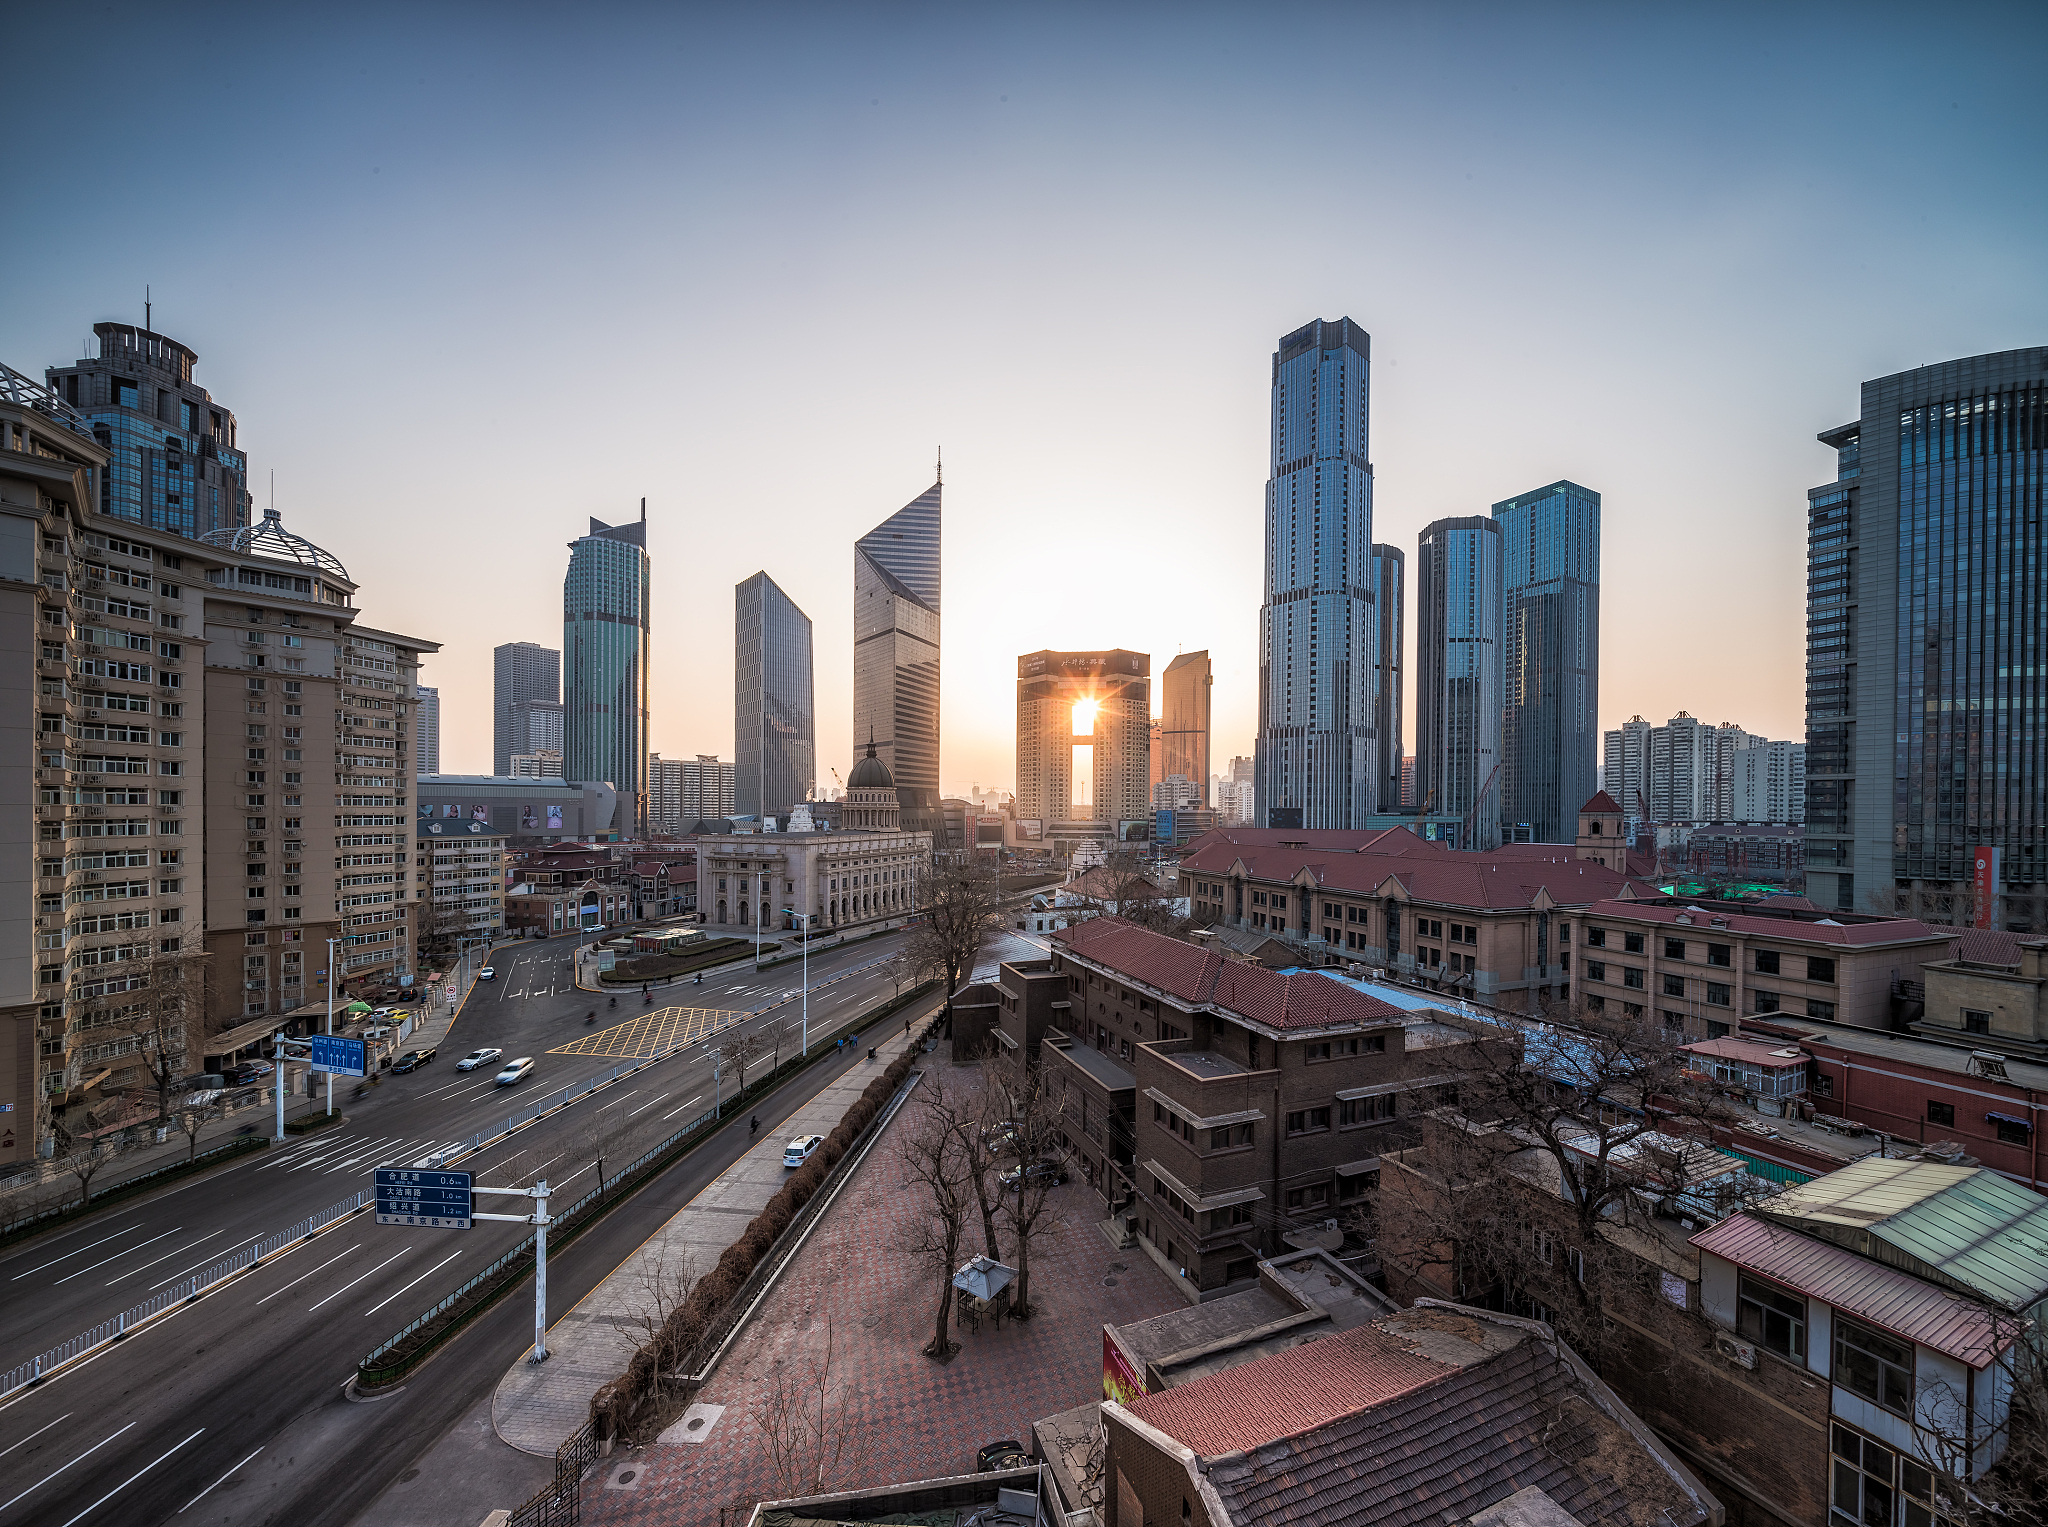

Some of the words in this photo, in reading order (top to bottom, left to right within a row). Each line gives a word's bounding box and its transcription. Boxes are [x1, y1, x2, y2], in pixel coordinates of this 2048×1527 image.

[389, 1172, 420, 1181] 合肥道
[387, 1187, 421, 1196] 大沽南路
[389, 1202, 420, 1211] 绍兴道
[407, 1216, 439, 1225] 南京路
